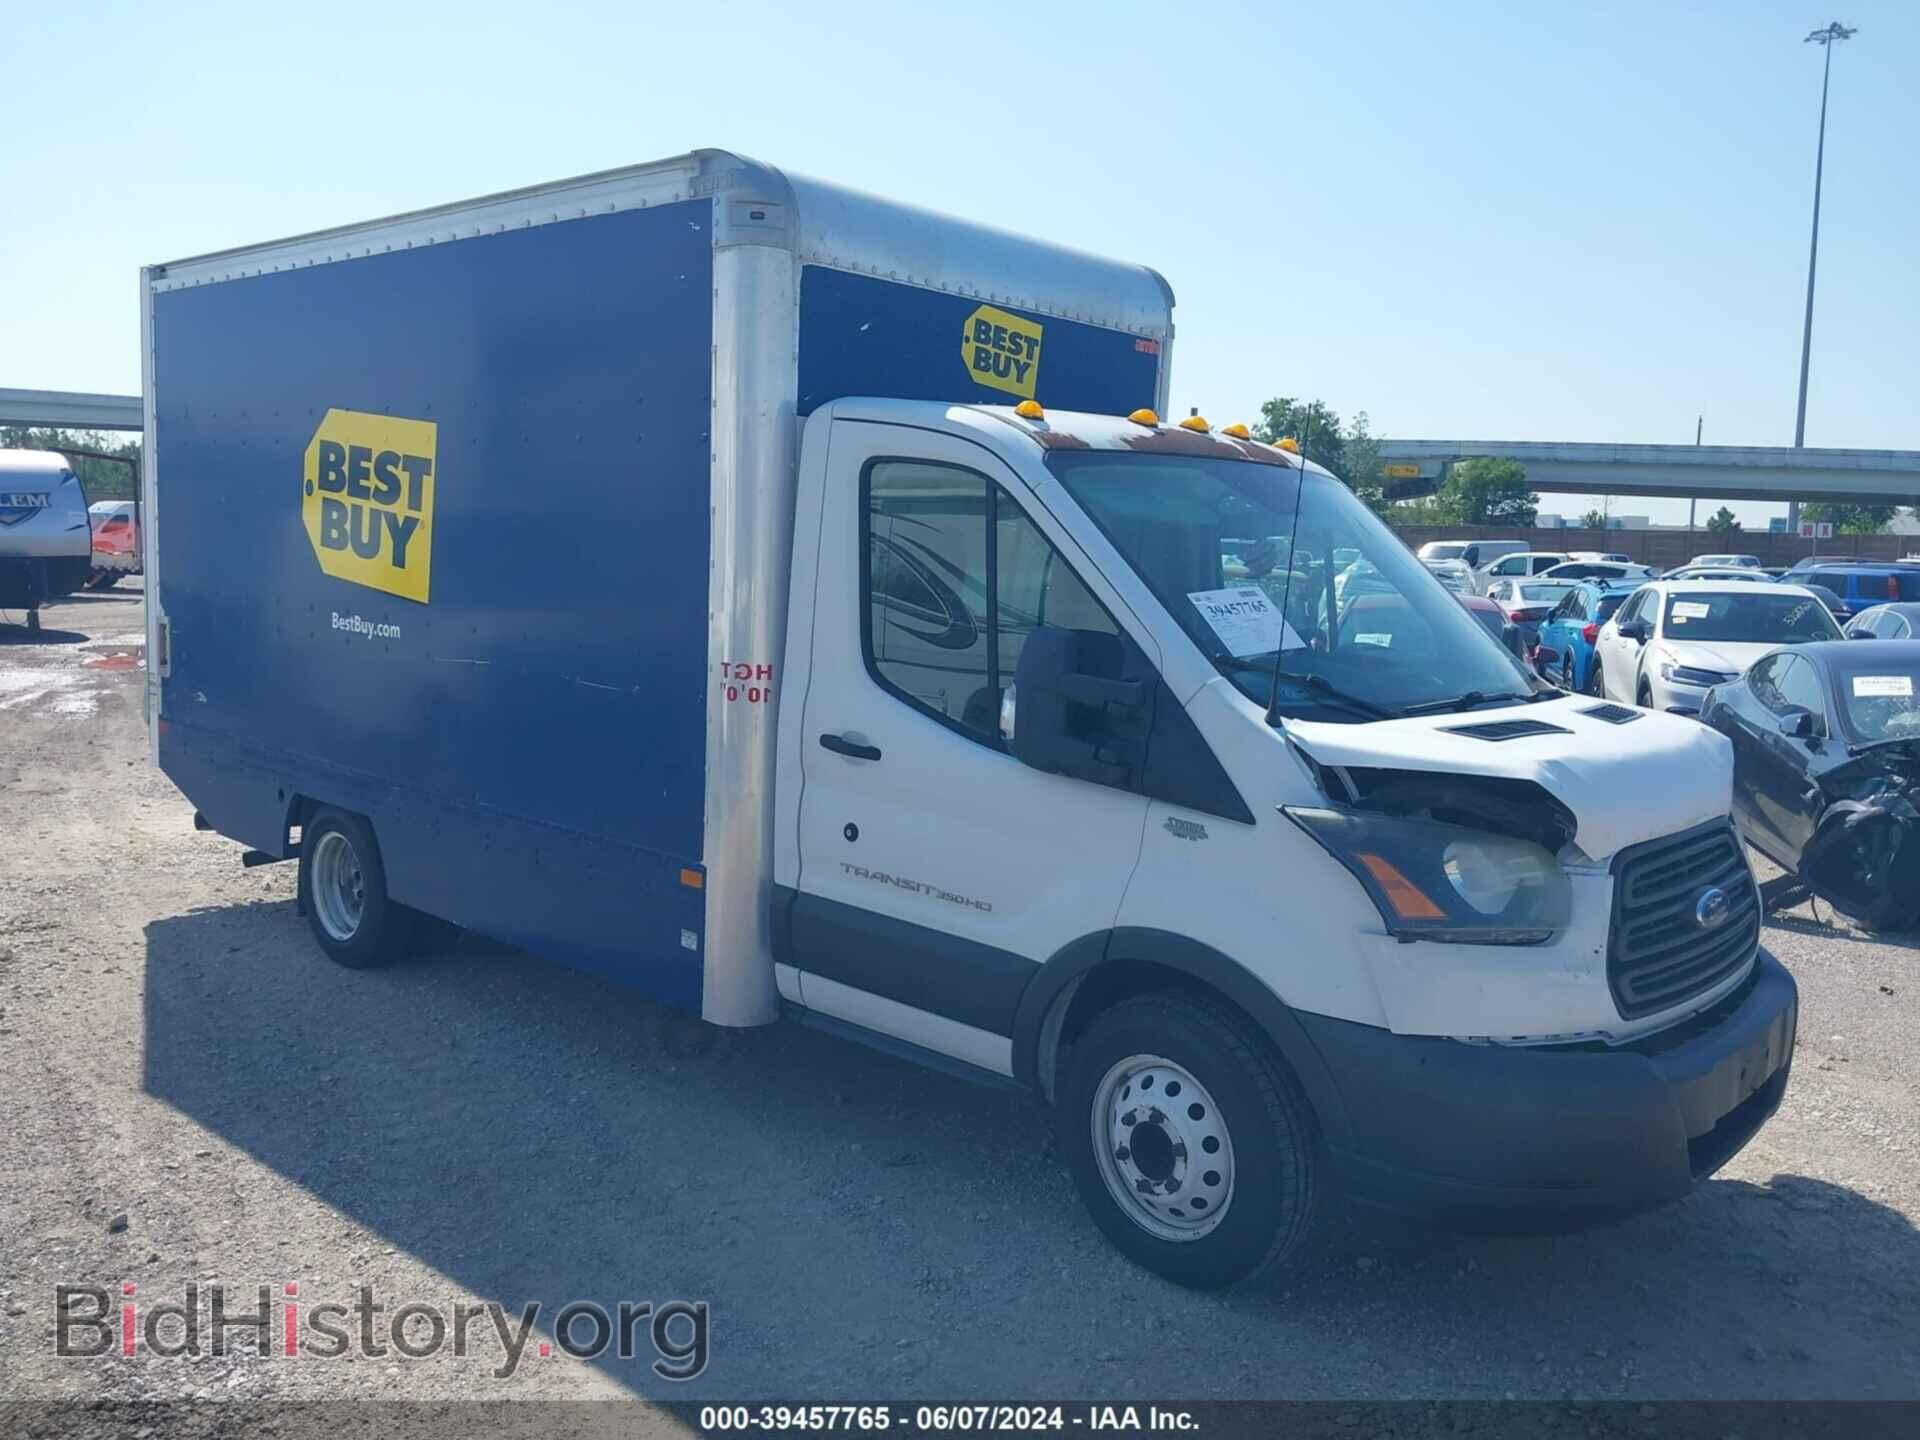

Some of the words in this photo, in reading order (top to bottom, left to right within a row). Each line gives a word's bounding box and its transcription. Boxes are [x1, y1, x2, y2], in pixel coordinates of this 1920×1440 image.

[972, 317, 1039, 361] BEST
[972, 346, 1032, 385] BUY
[317, 439, 433, 512] BEST
[319, 497, 421, 569] BUY
[331, 611, 401, 640] BestBuy.com
[1207, 600, 1269, 618] 39457765
[840, 862, 936, 895] TRANSIT
